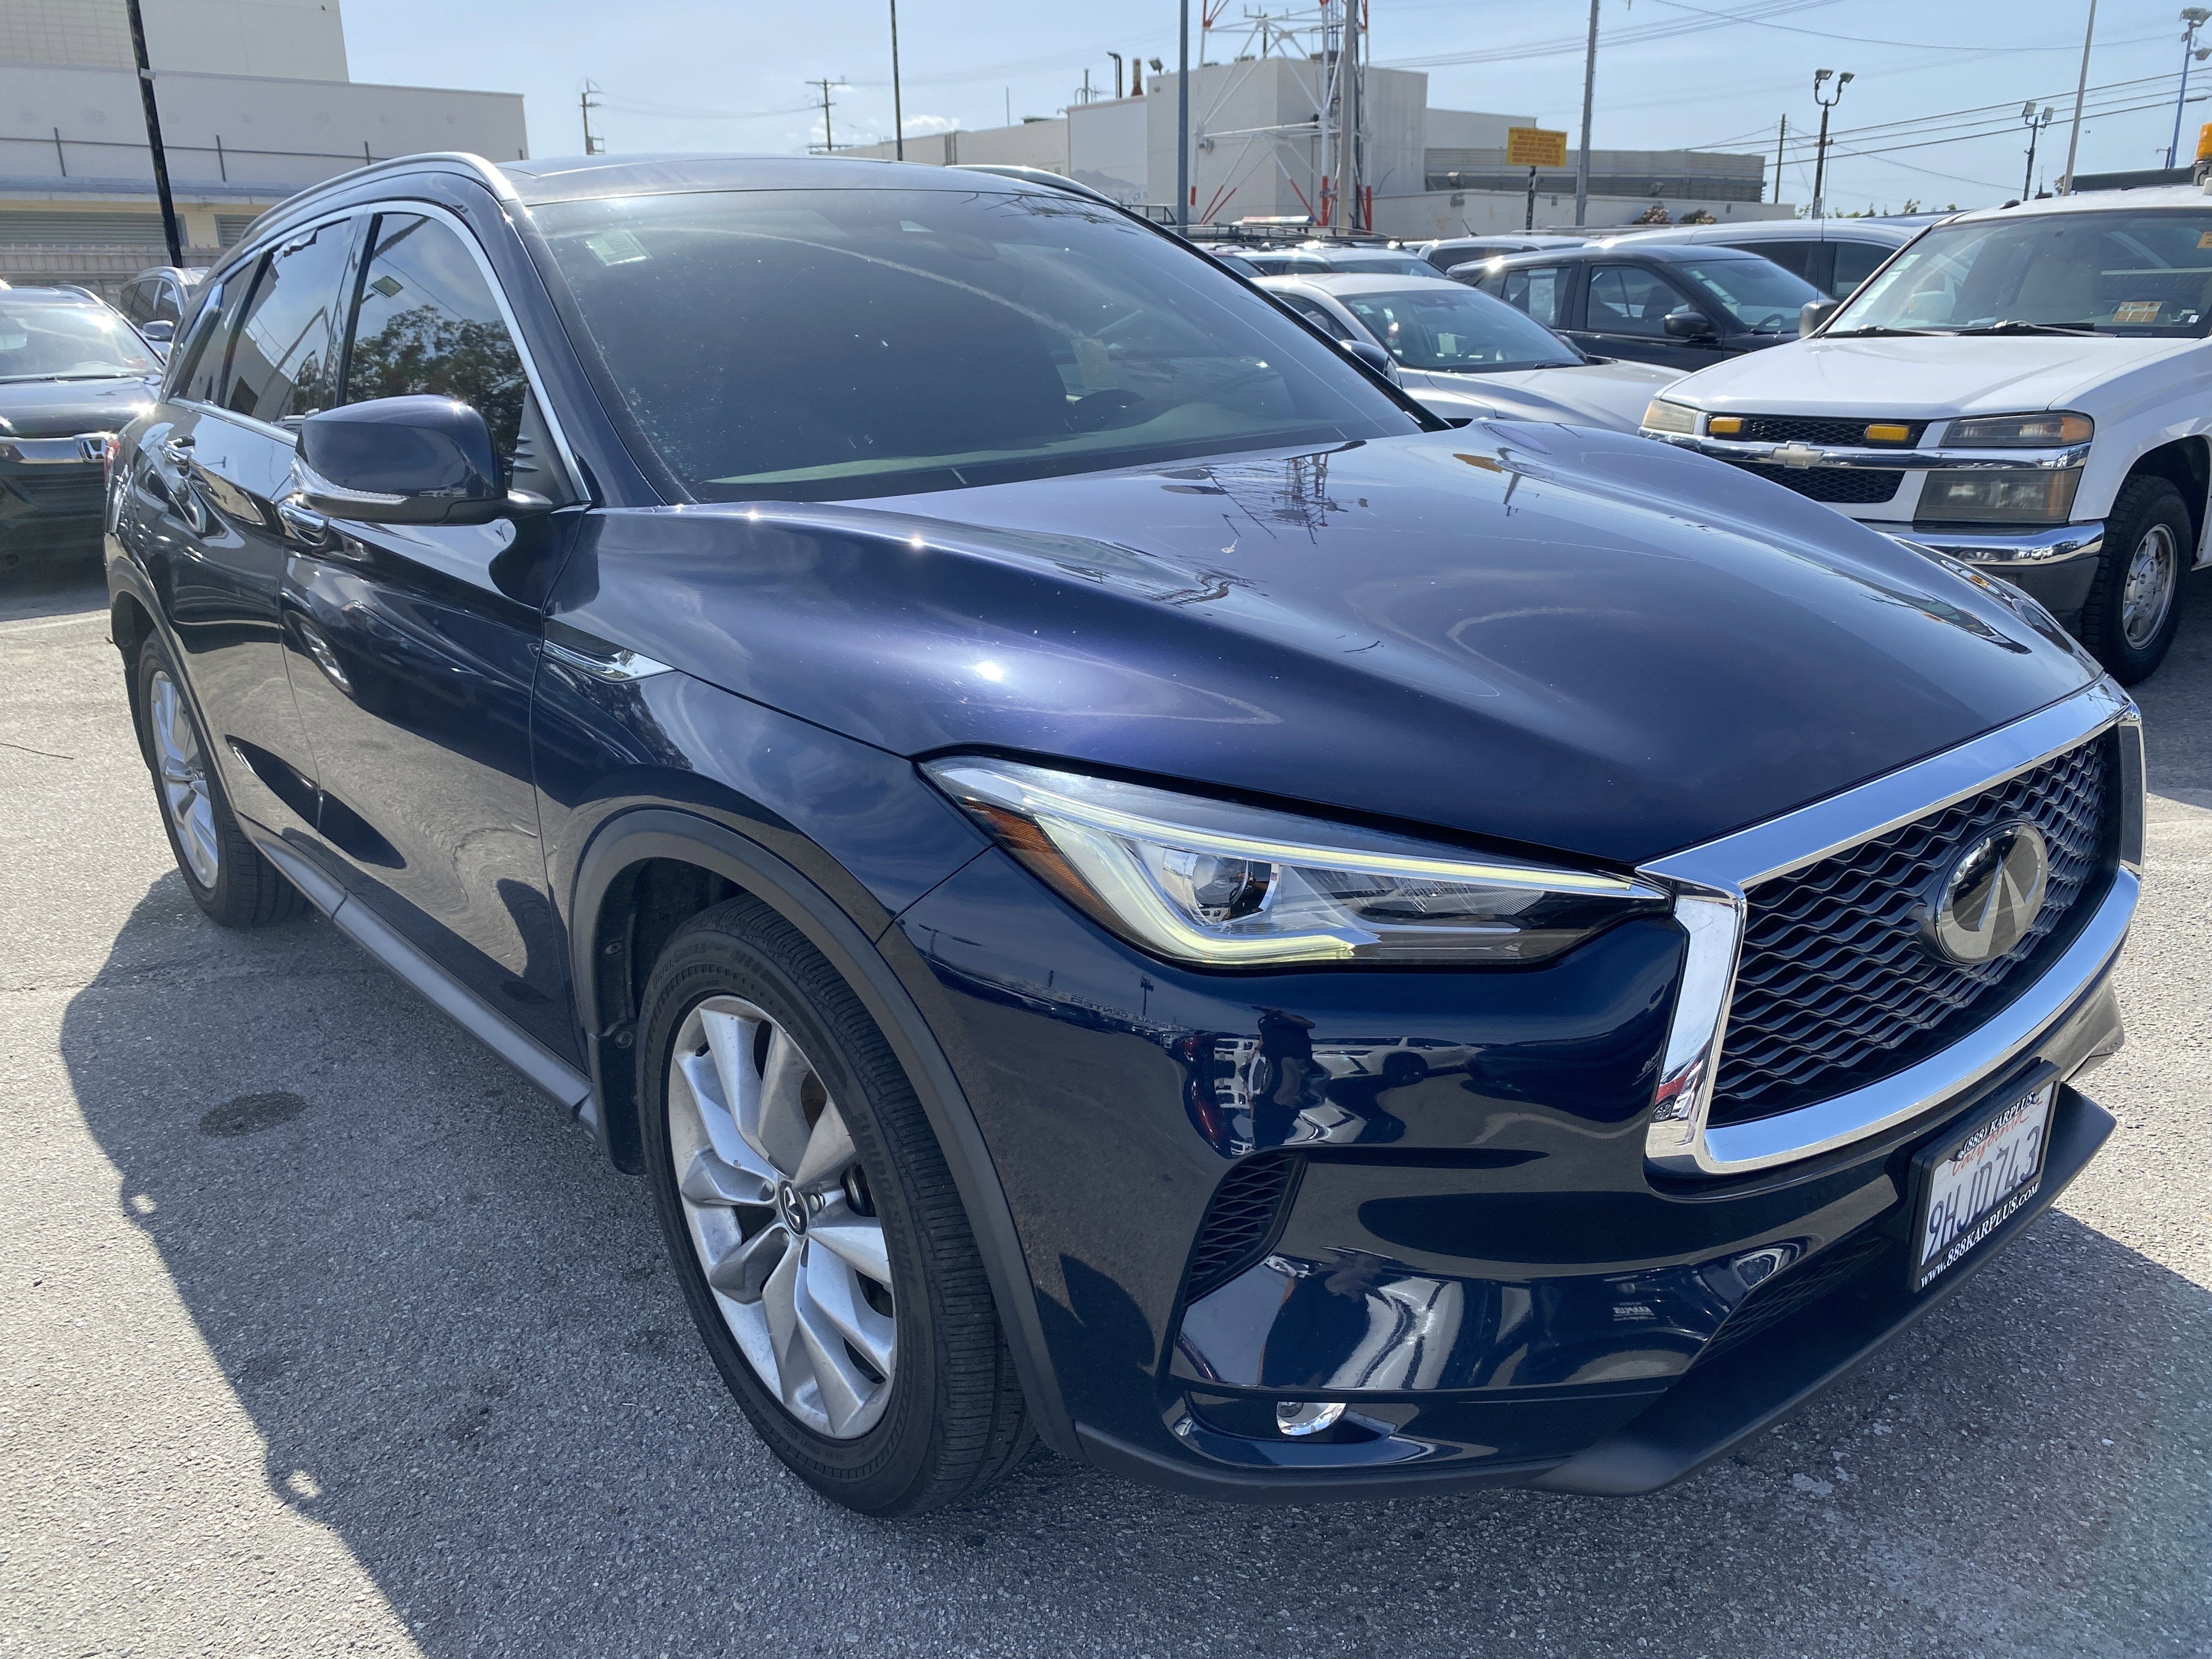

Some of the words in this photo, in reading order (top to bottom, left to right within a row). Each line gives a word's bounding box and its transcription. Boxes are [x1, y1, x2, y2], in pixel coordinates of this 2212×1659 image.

[1963, 1126, 1988, 1153] (888)
[1989, 1091, 2034, 1136] KARPLUS
[1925, 1125, 2040, 1262] 9HJD743
